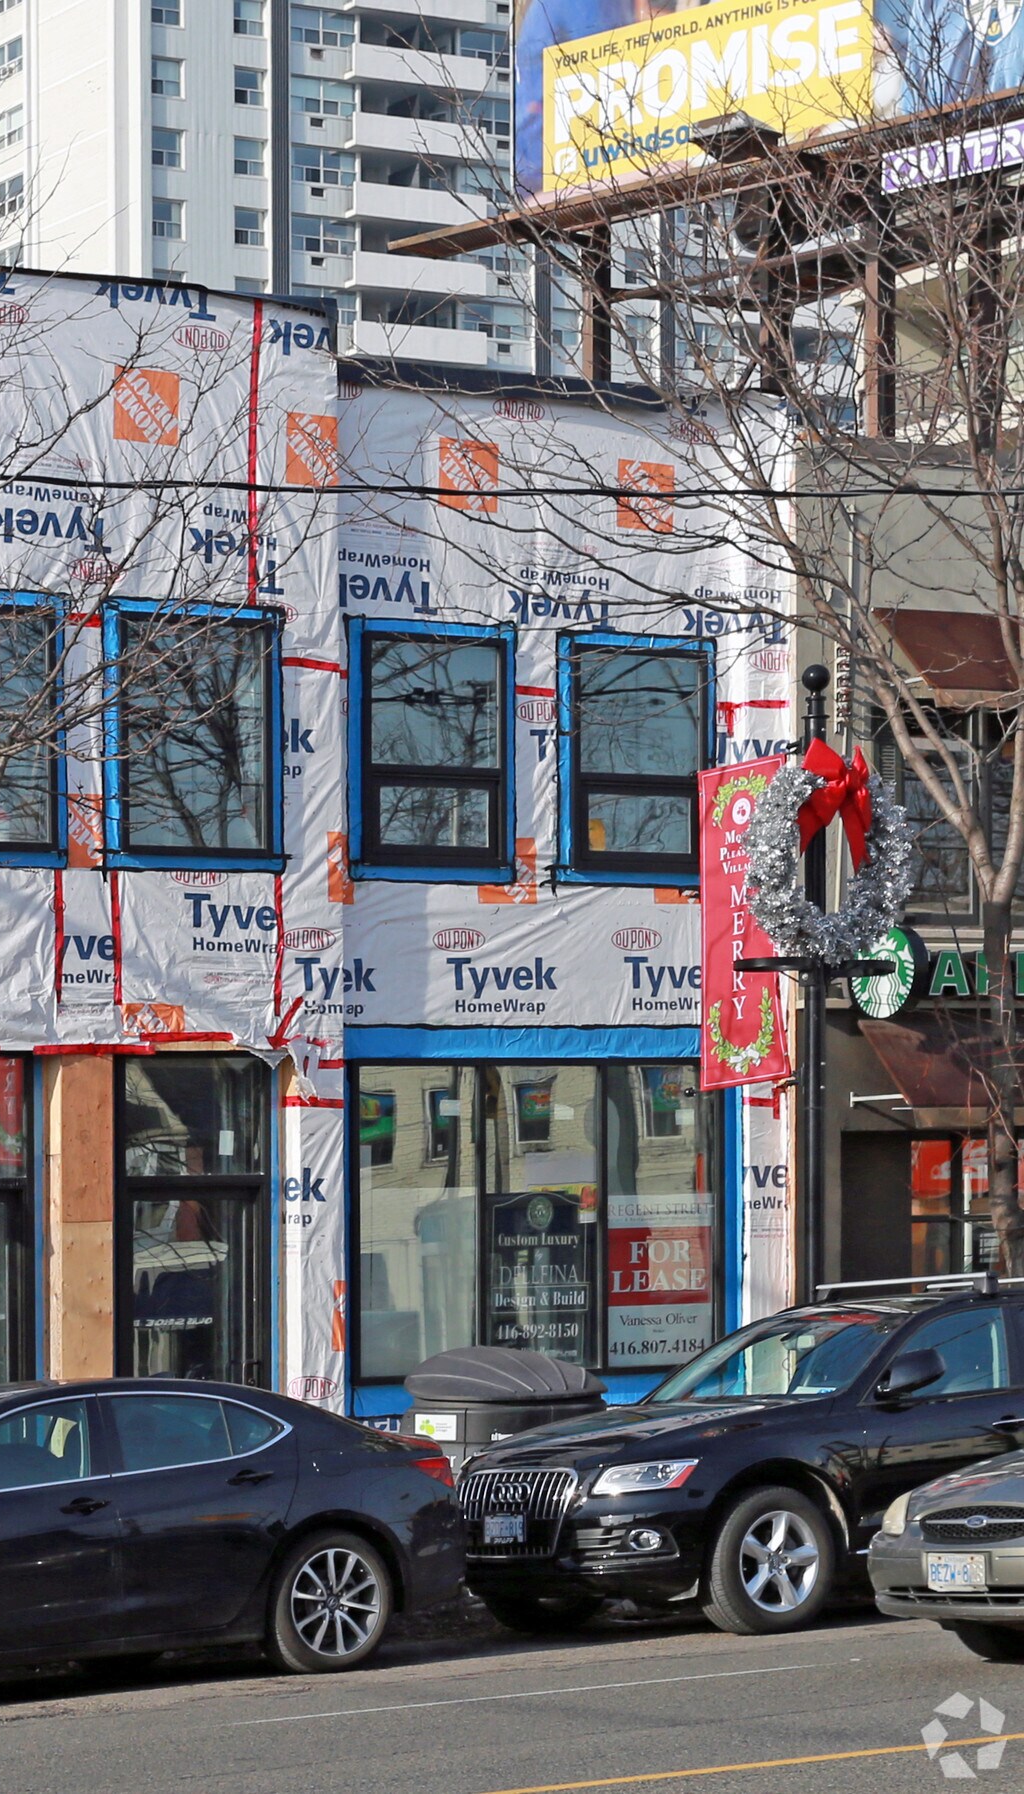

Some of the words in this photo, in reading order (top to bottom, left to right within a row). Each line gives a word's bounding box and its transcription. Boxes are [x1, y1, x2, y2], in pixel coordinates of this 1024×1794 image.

[555, 48, 589, 69] YOUR
[592, 41, 622, 62] LIFE.
[625, 35, 649, 53] THE
[647, 21, 702, 44] WORLD.
[705, 4, 773, 31] ANYTHING
[555, 2, 863, 145] PROMISE
[555, 125, 690, 174] @uwindso
[888, 127, 1024, 186] OUTFR
[338, 548, 431, 573] HomeWrap
[520, 567, 610, 591] HomeWrap
[508, 588, 616, 632] Tyvek
[184, 892, 276, 938] Tyve
[192, 937, 277, 954] HomeWra
[729, 884, 749, 1020] MERRY
[446, 957, 558, 999] Tyvek
[623, 956, 702, 998] Tyve
[455, 998, 546, 1015] HomeWrap
[632, 997, 701, 1012] HomeWr
[608, 1203, 662, 1218] REGENT
[664, 1202, 711, 1216] STREET
[498, 1233, 538, 1248] Custom
[541, 1232, 581, 1249] Luxury
[629, 1239, 691, 1264] FOR
[611, 1268, 706, 1293] LEASE
[495, 1292, 537, 1309] Design
[539, 1292, 550, 1306] &
[552, 1291, 585, 1306] Build
[619, 1314, 662, 1327] Vanessa
[665, 1312, 698, 1326] Oliver
[609, 1337, 706, 1356] 416.807.4184
